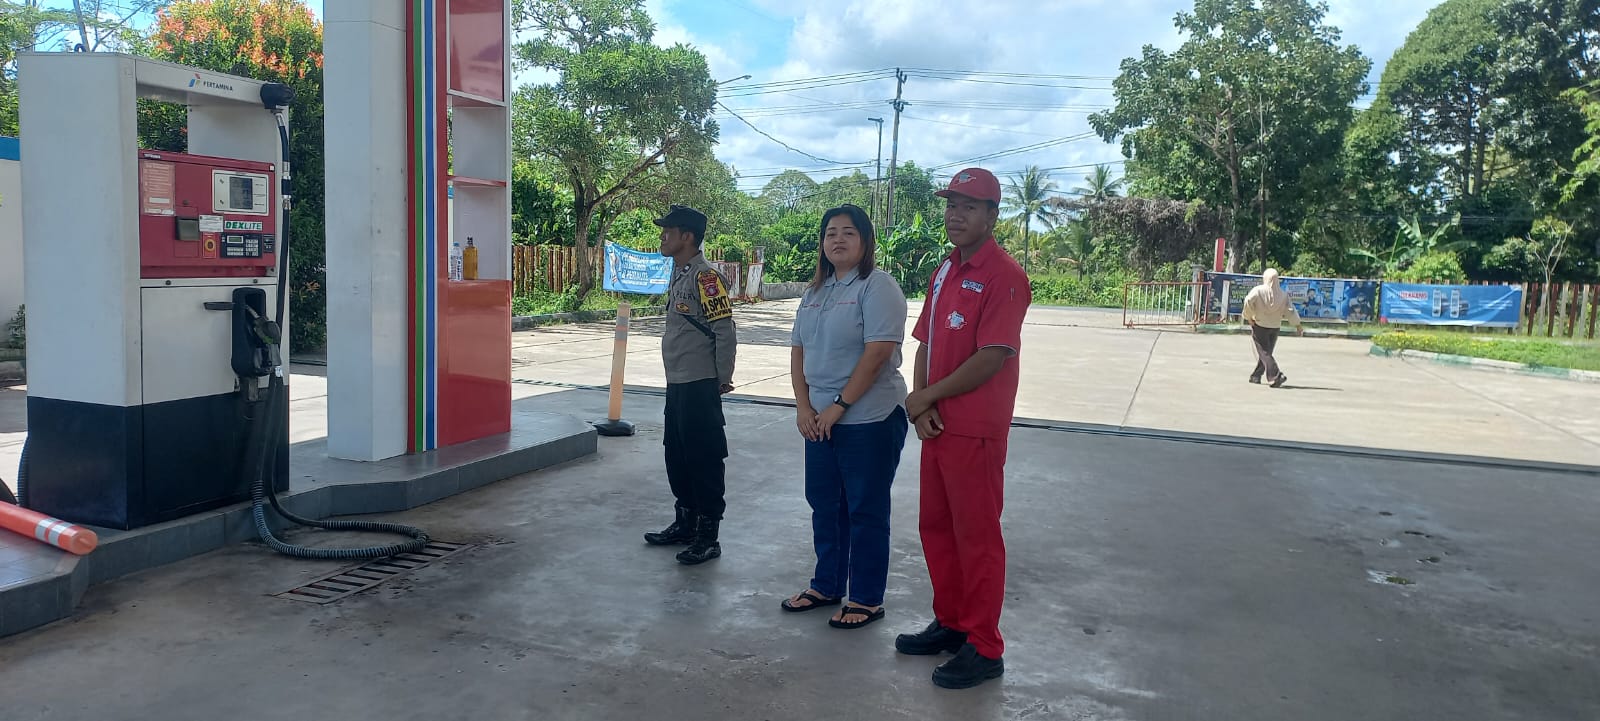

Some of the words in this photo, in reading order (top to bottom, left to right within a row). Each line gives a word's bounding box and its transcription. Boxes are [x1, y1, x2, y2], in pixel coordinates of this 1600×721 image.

[203, 81, 233, 91] PERTAMINA
[225, 222, 262, 230] DEXLITE
[708, 296, 728, 312] SPKT
